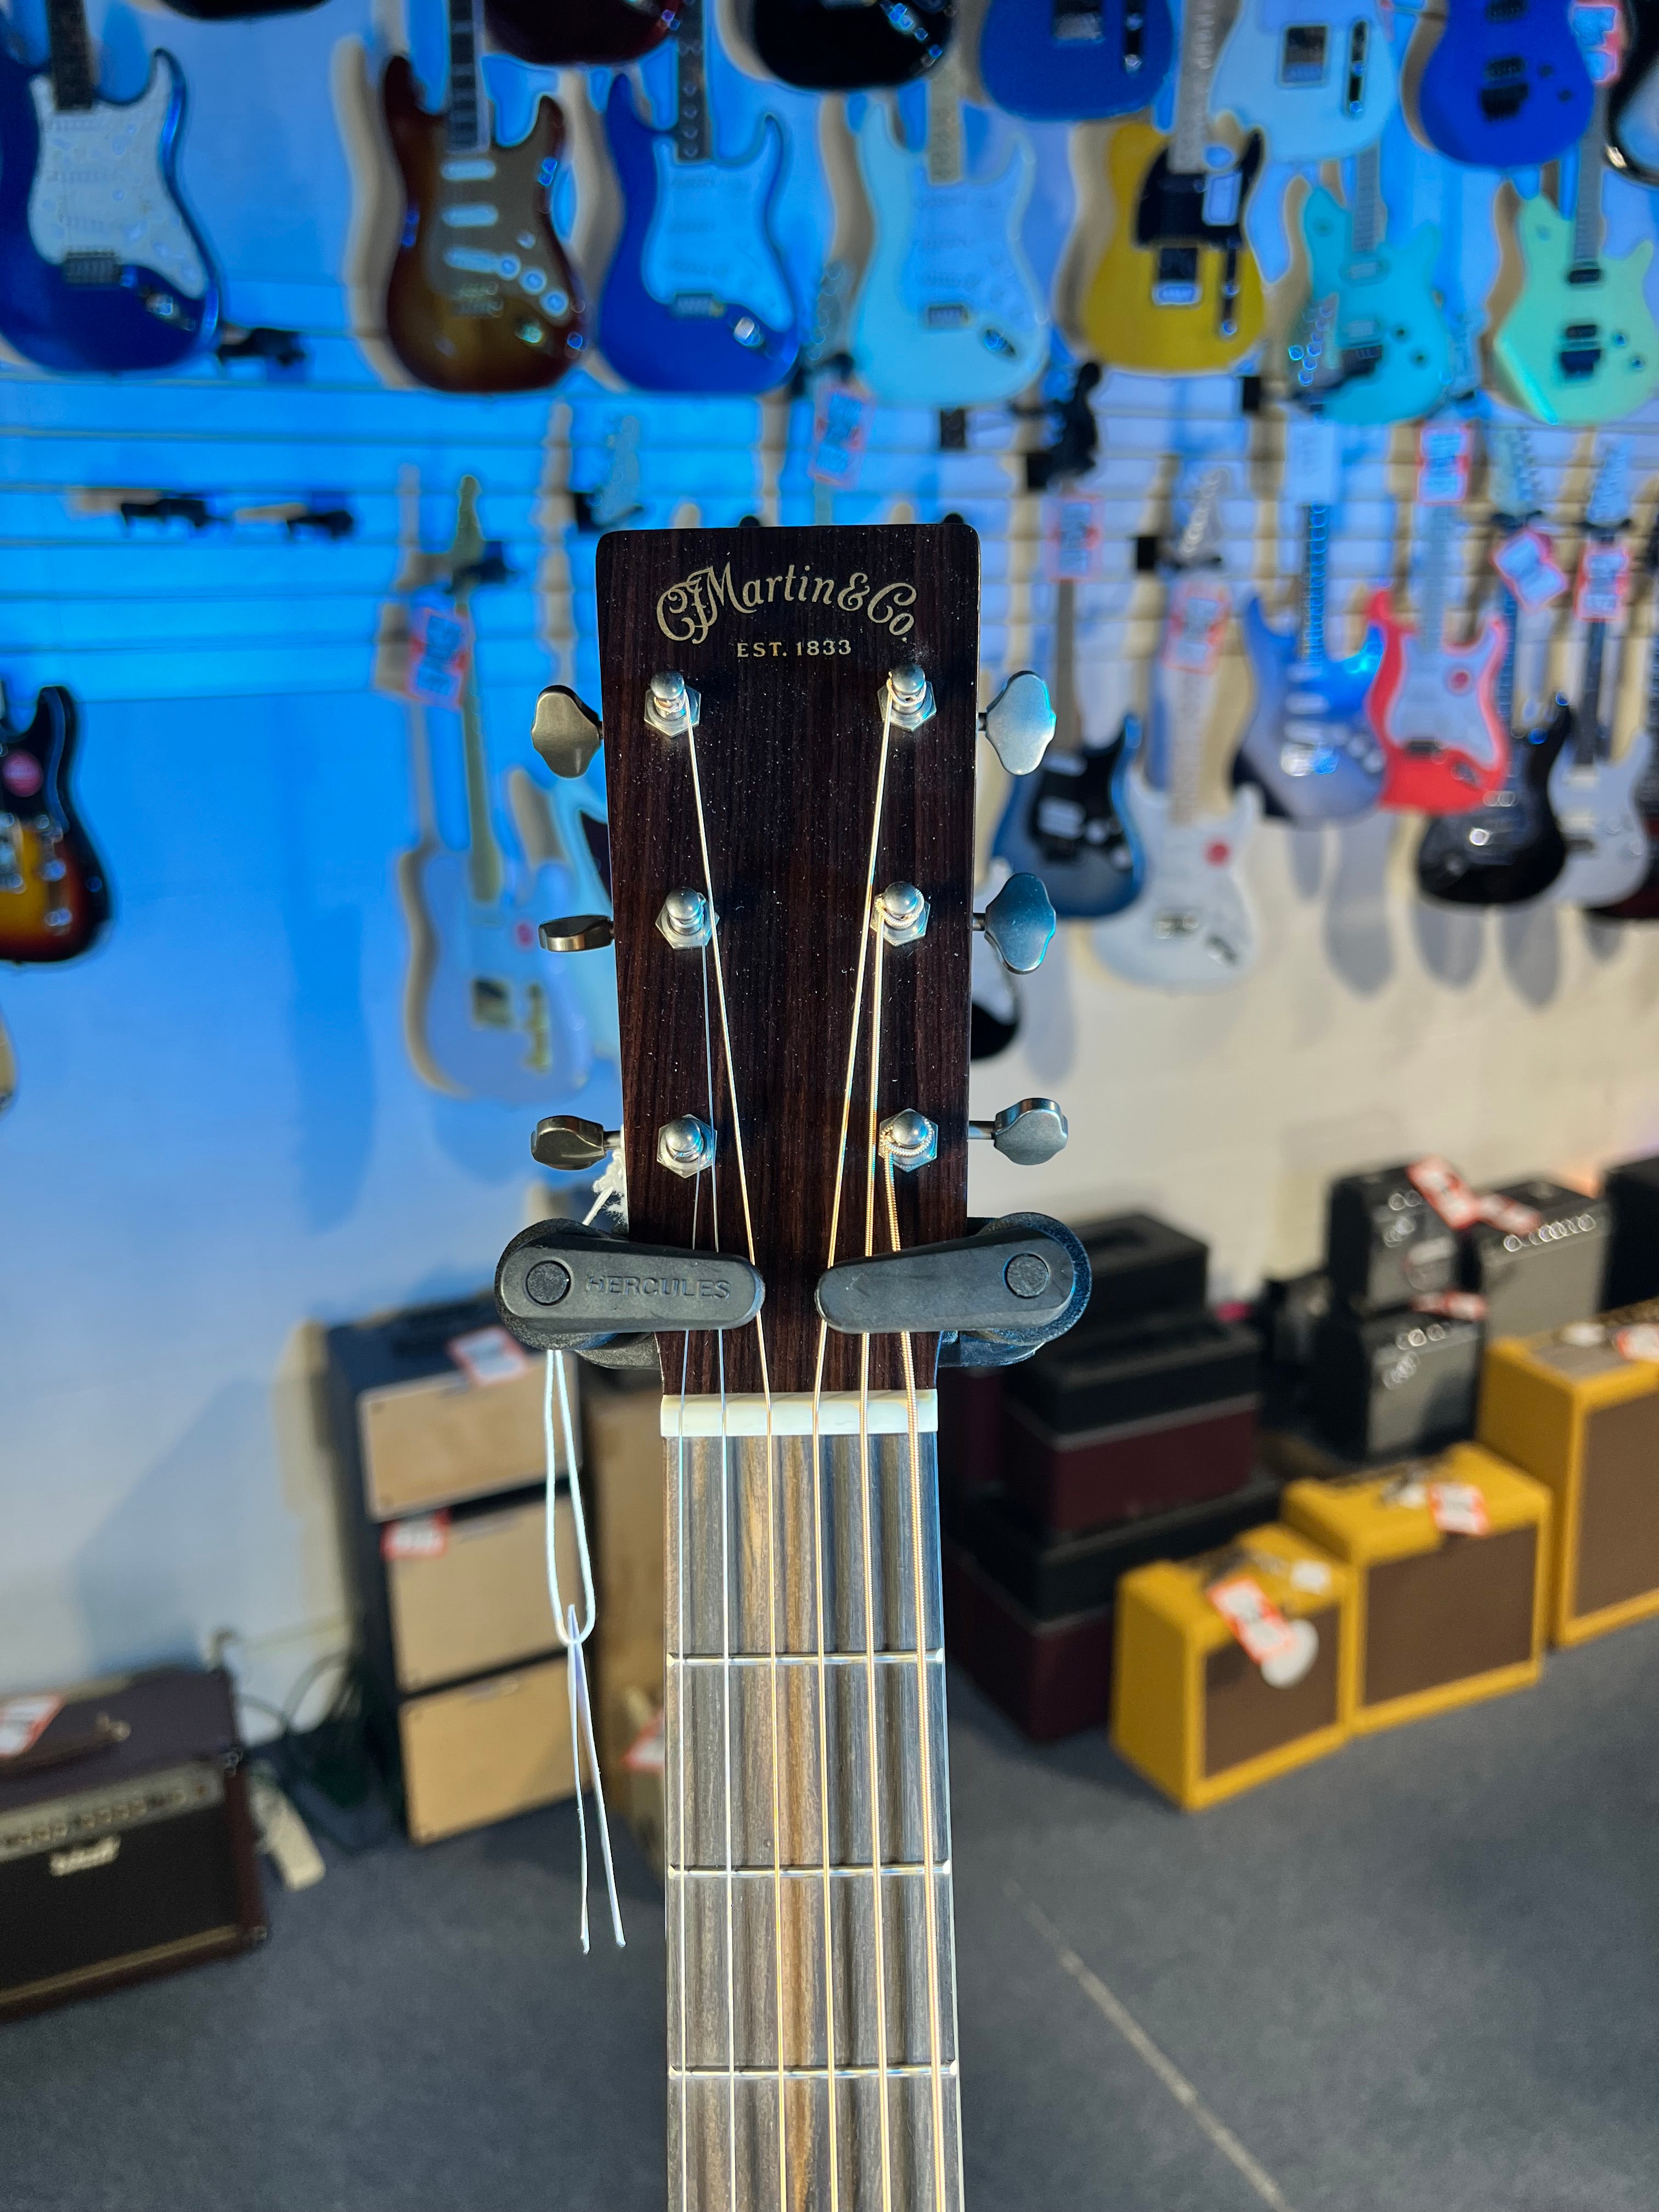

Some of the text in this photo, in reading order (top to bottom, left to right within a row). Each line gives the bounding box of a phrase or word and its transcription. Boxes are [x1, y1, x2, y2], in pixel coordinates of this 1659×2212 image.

[737, 639, 851, 657] EST. 1833
[585, 1274, 731, 1300] HERCULES
